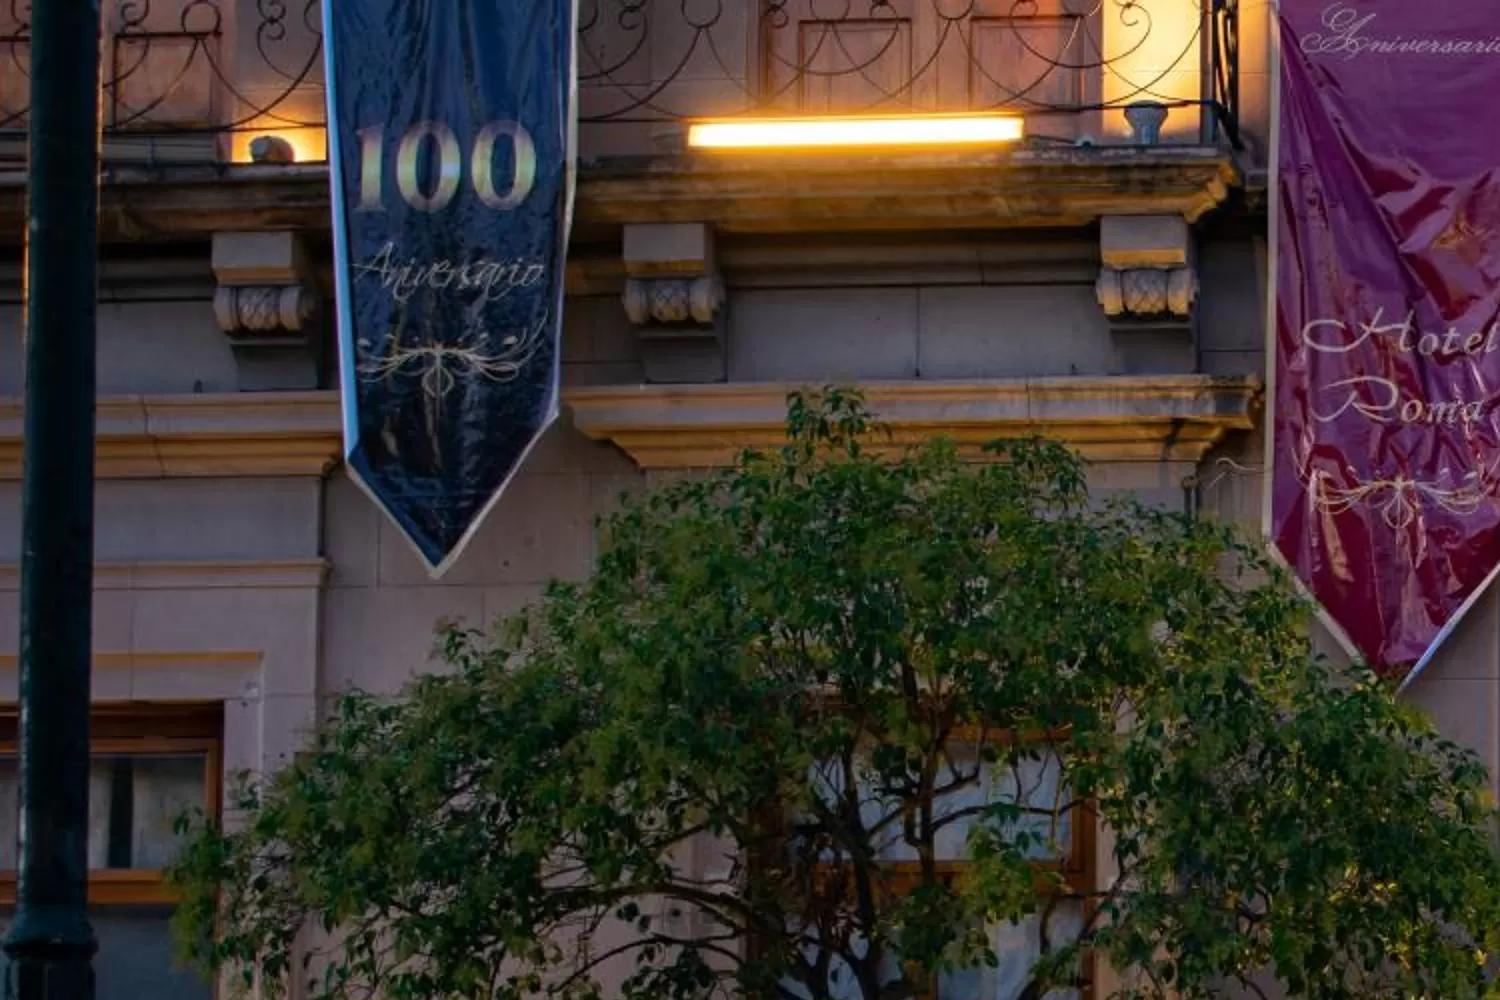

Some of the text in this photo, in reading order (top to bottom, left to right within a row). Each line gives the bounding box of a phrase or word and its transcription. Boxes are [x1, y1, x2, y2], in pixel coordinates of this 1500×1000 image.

[354, 119, 537, 212] 100
[348, 240, 545, 301] Aniversario
[1302, 305, 1499, 358] Hotel
[1310, 375, 1485, 430] Roma
